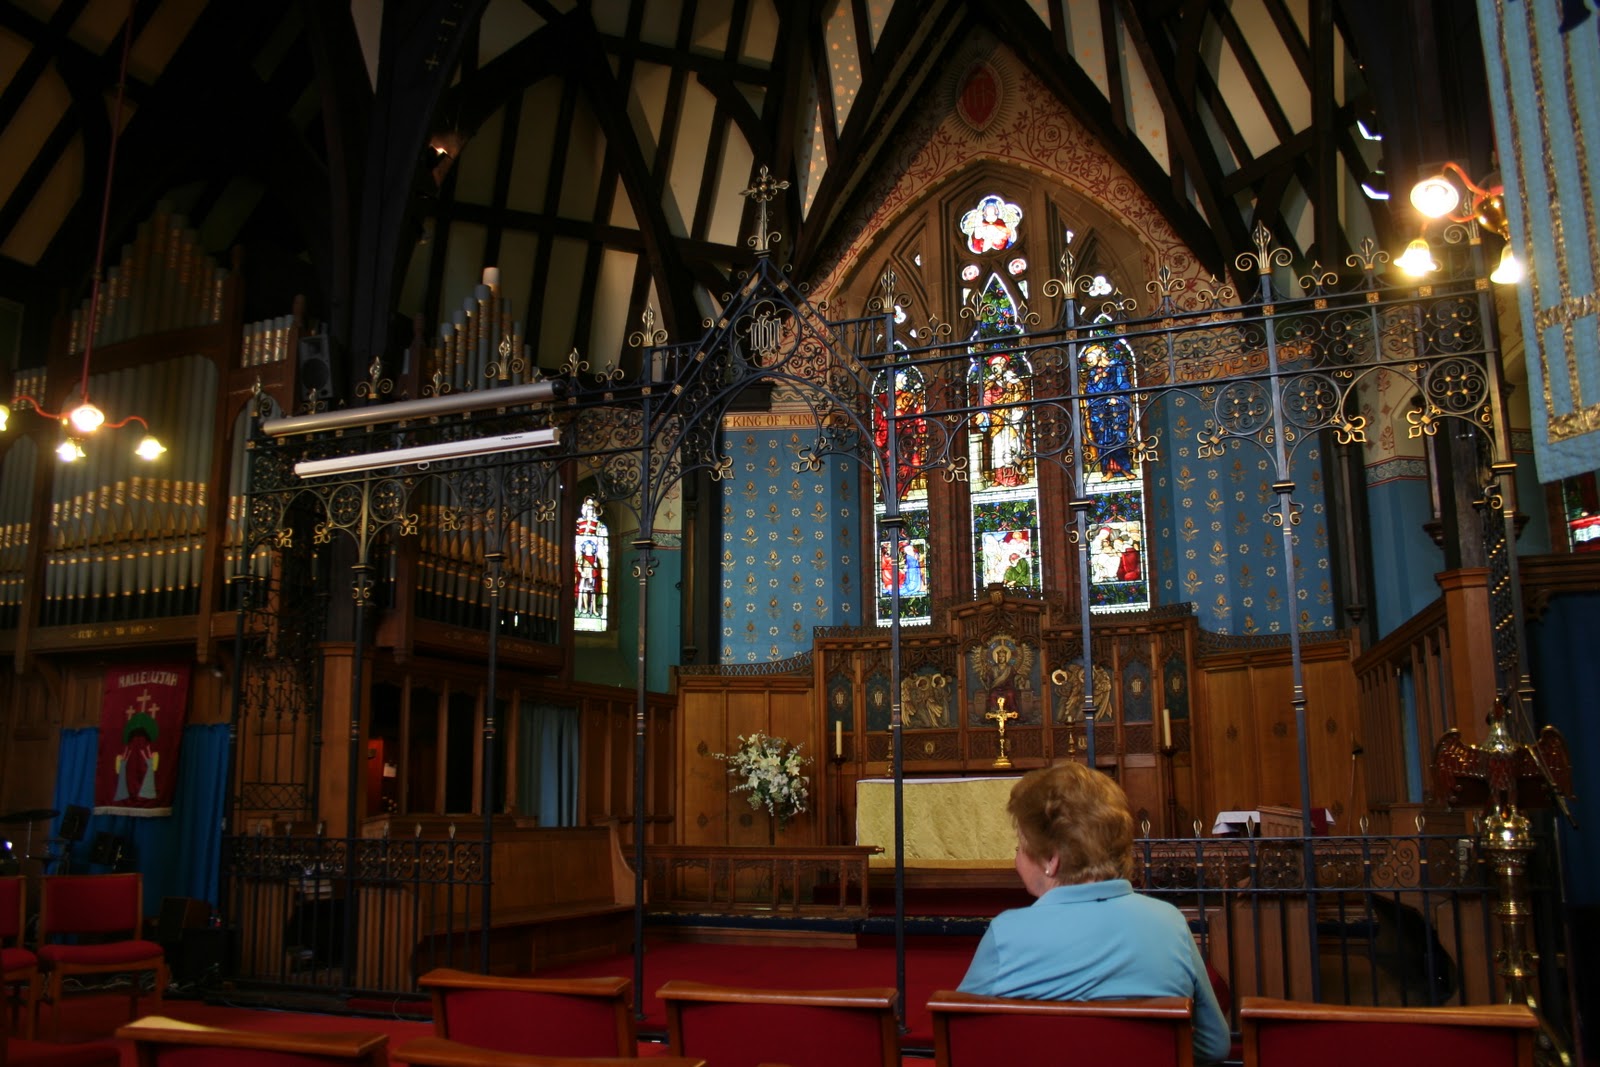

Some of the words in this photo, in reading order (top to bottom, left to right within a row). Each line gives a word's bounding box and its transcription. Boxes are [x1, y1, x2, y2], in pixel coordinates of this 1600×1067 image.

[733, 415, 761, 427] KING
[767, 414, 781, 426] OF
[789, 414, 821, 426] KING
[118, 671, 178, 688] HALLELUJAH
